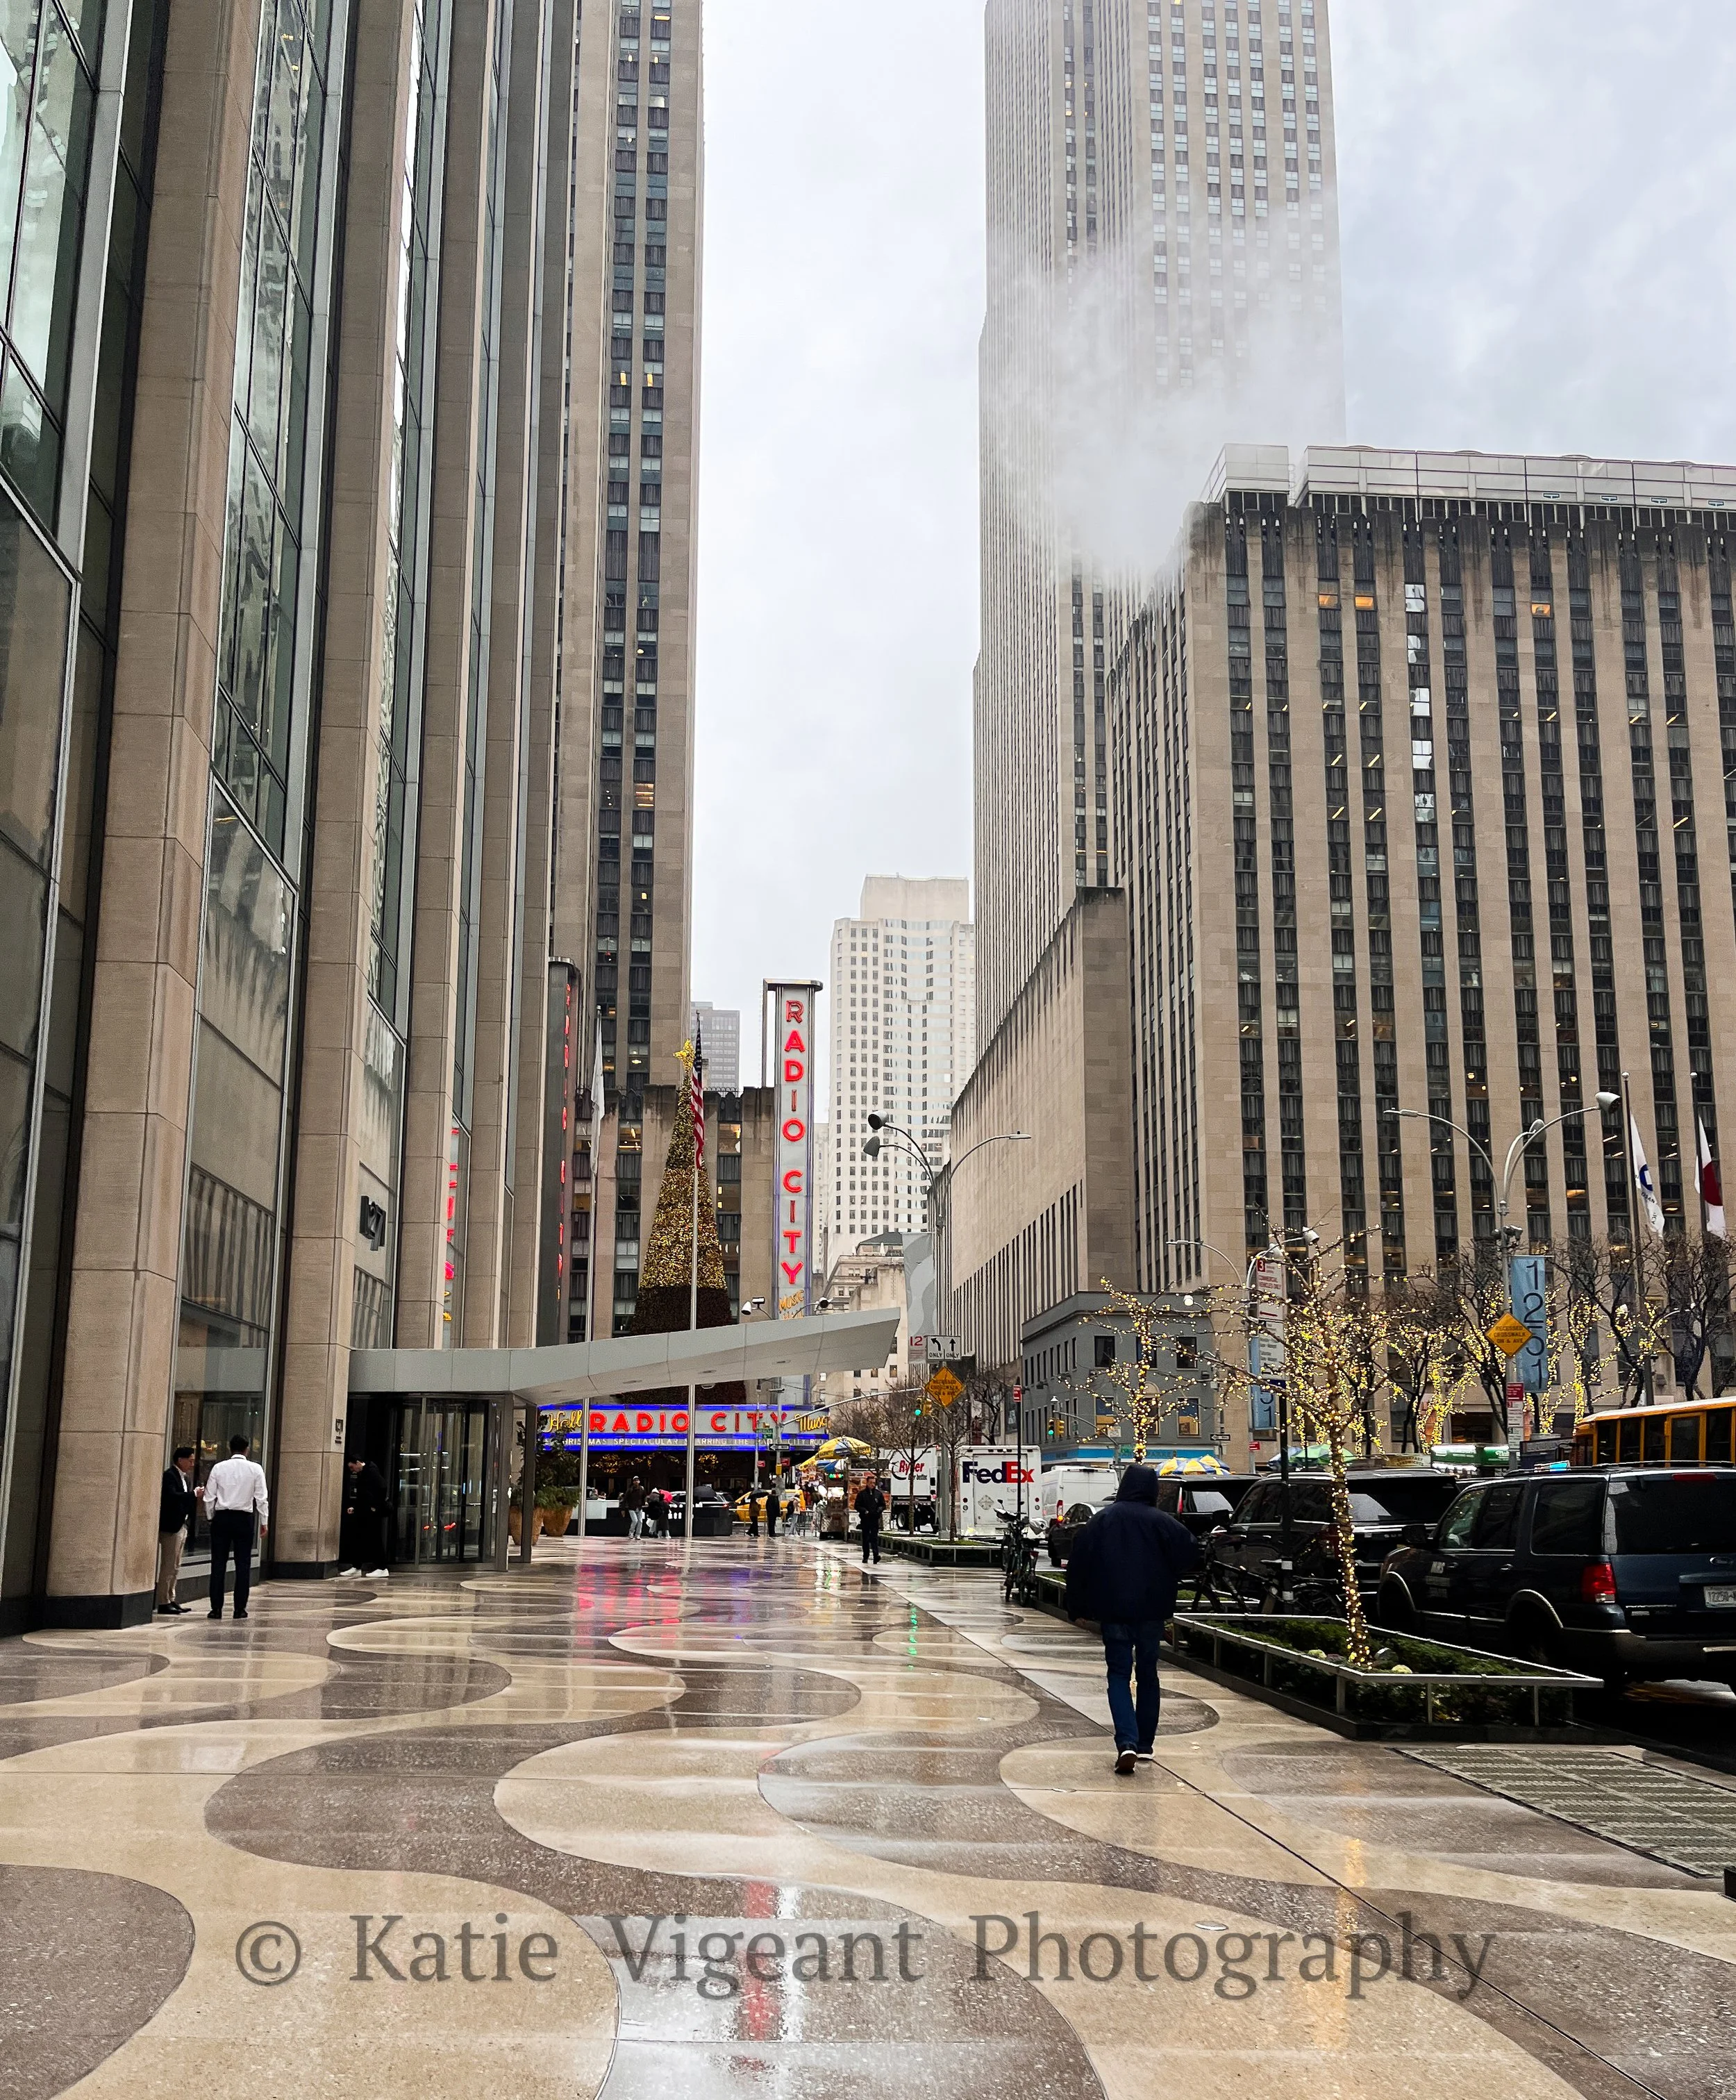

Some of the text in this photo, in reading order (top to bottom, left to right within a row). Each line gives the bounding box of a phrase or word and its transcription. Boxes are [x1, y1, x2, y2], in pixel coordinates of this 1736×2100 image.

[782, 999, 806, 1142] RADIO
[781, 1169, 804, 1284] CITY
[590, 1411, 690, 1432] RADIO
[710, 1412, 787, 1432] CITY
[899, 1460, 925, 1475] Ryer
[962, 1461, 1035, 1484] FedEx
